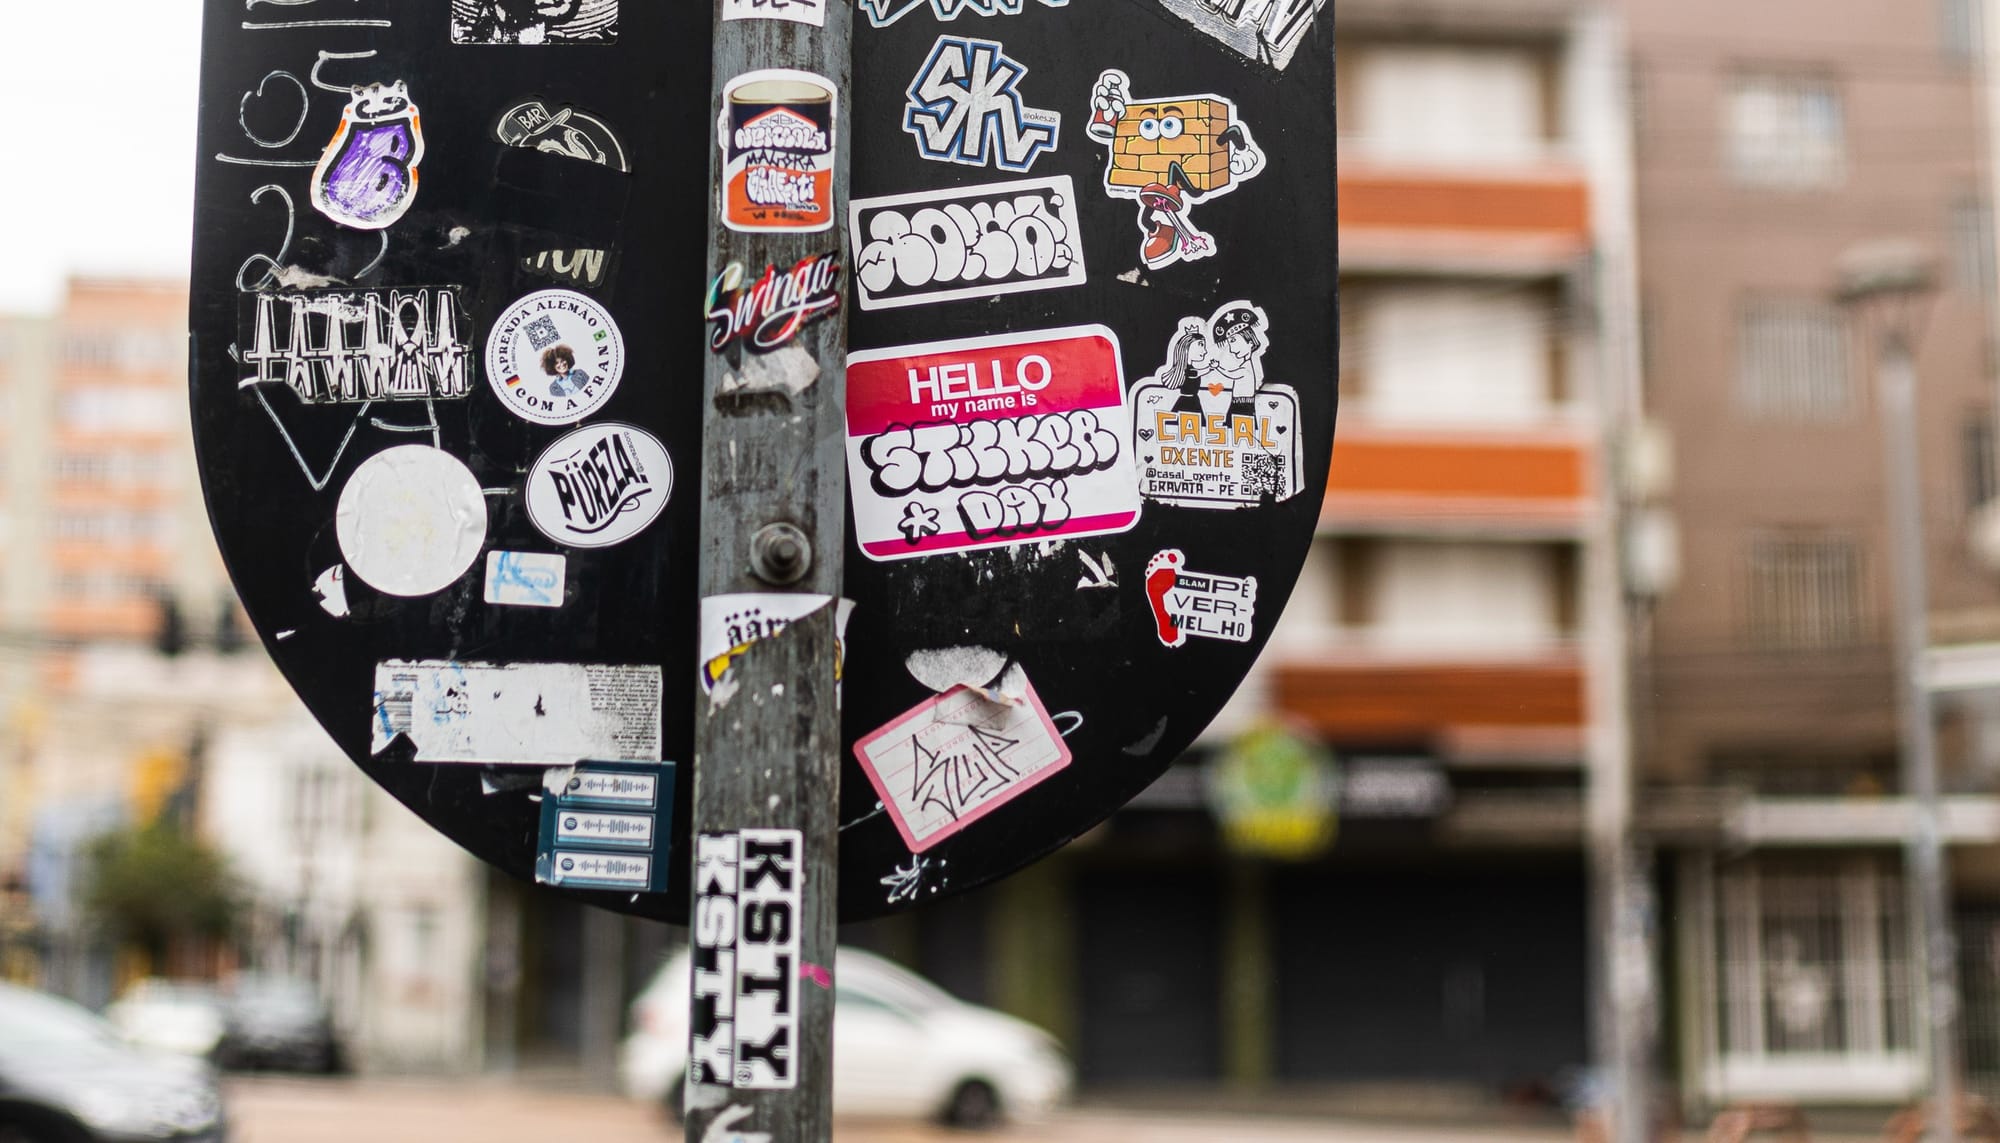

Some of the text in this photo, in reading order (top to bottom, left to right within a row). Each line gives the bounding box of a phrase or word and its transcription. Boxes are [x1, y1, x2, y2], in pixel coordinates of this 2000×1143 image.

[518, 108, 546, 130] BAR
[707, 254, 838, 348] Swinga
[499, 309, 531, 375] APRENDA
[536, 300, 598, 327] ALEMÃO
[515, 345, 609, 412] COM A FRAN
[907, 354, 1053, 404] HELLO
[931, 391, 1037, 419] my name is
[1155, 409, 1278, 449] CASAL
[1160, 446, 1235, 469] OXENTE
[957, 478, 1071, 541] DAY
[1219, 484, 1235, 496] PE
[1179, 578, 1206, 589] SLAM
[1170, 613, 1245, 638] MELHO
[691, 834, 737, 1084] KSTY
[739, 839, 793, 1081] KSTY
